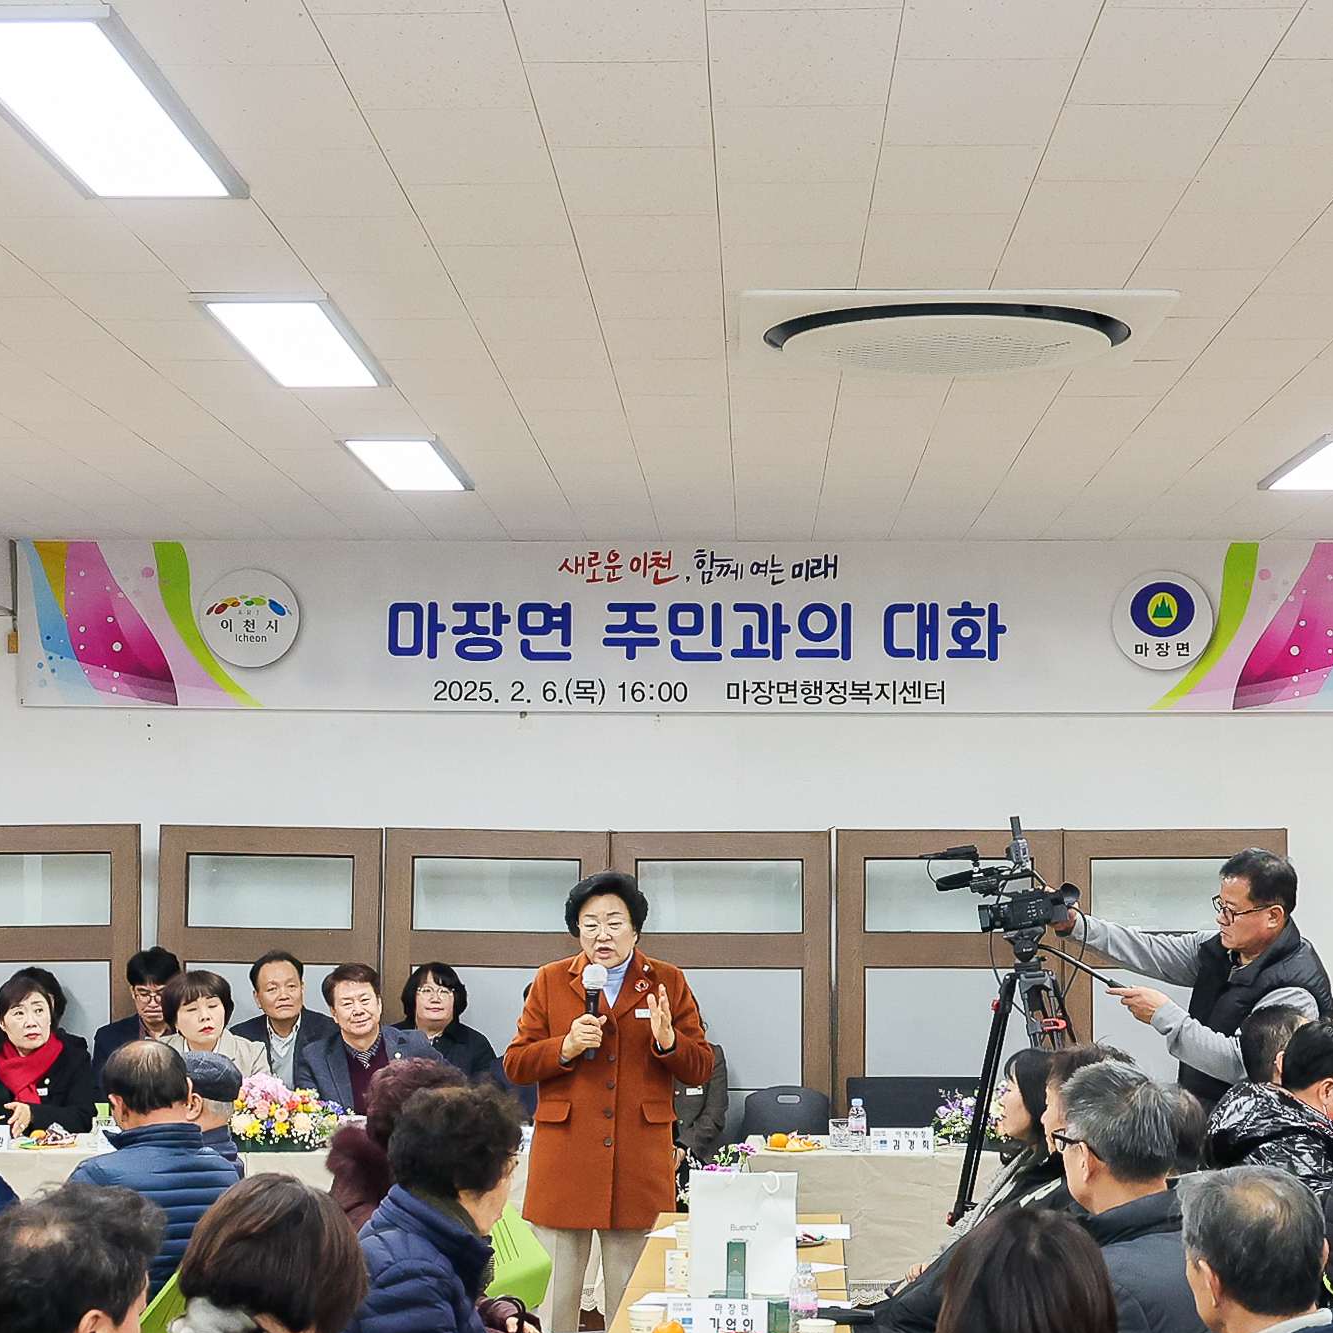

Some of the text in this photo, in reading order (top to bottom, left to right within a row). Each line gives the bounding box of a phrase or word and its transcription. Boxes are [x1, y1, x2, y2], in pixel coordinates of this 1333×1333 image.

[558, 550, 623, 583] 새로운
[694, 549, 744, 585] 함께
[750, 554, 785, 586] 여는
[791, 553, 839, 582] 미래
[220, 619, 279, 633] 이천시
[387, 601, 1008, 663] 마장면 주민과의 대화
[235, 633, 267, 643] Icheon
[1134, 641, 1190, 658] 마장면
[433, 677, 945, 706] 2025. 2. 6.(목) 16:00 마장면행정복지센터
[714, 1303, 749, 1316] 마장면
